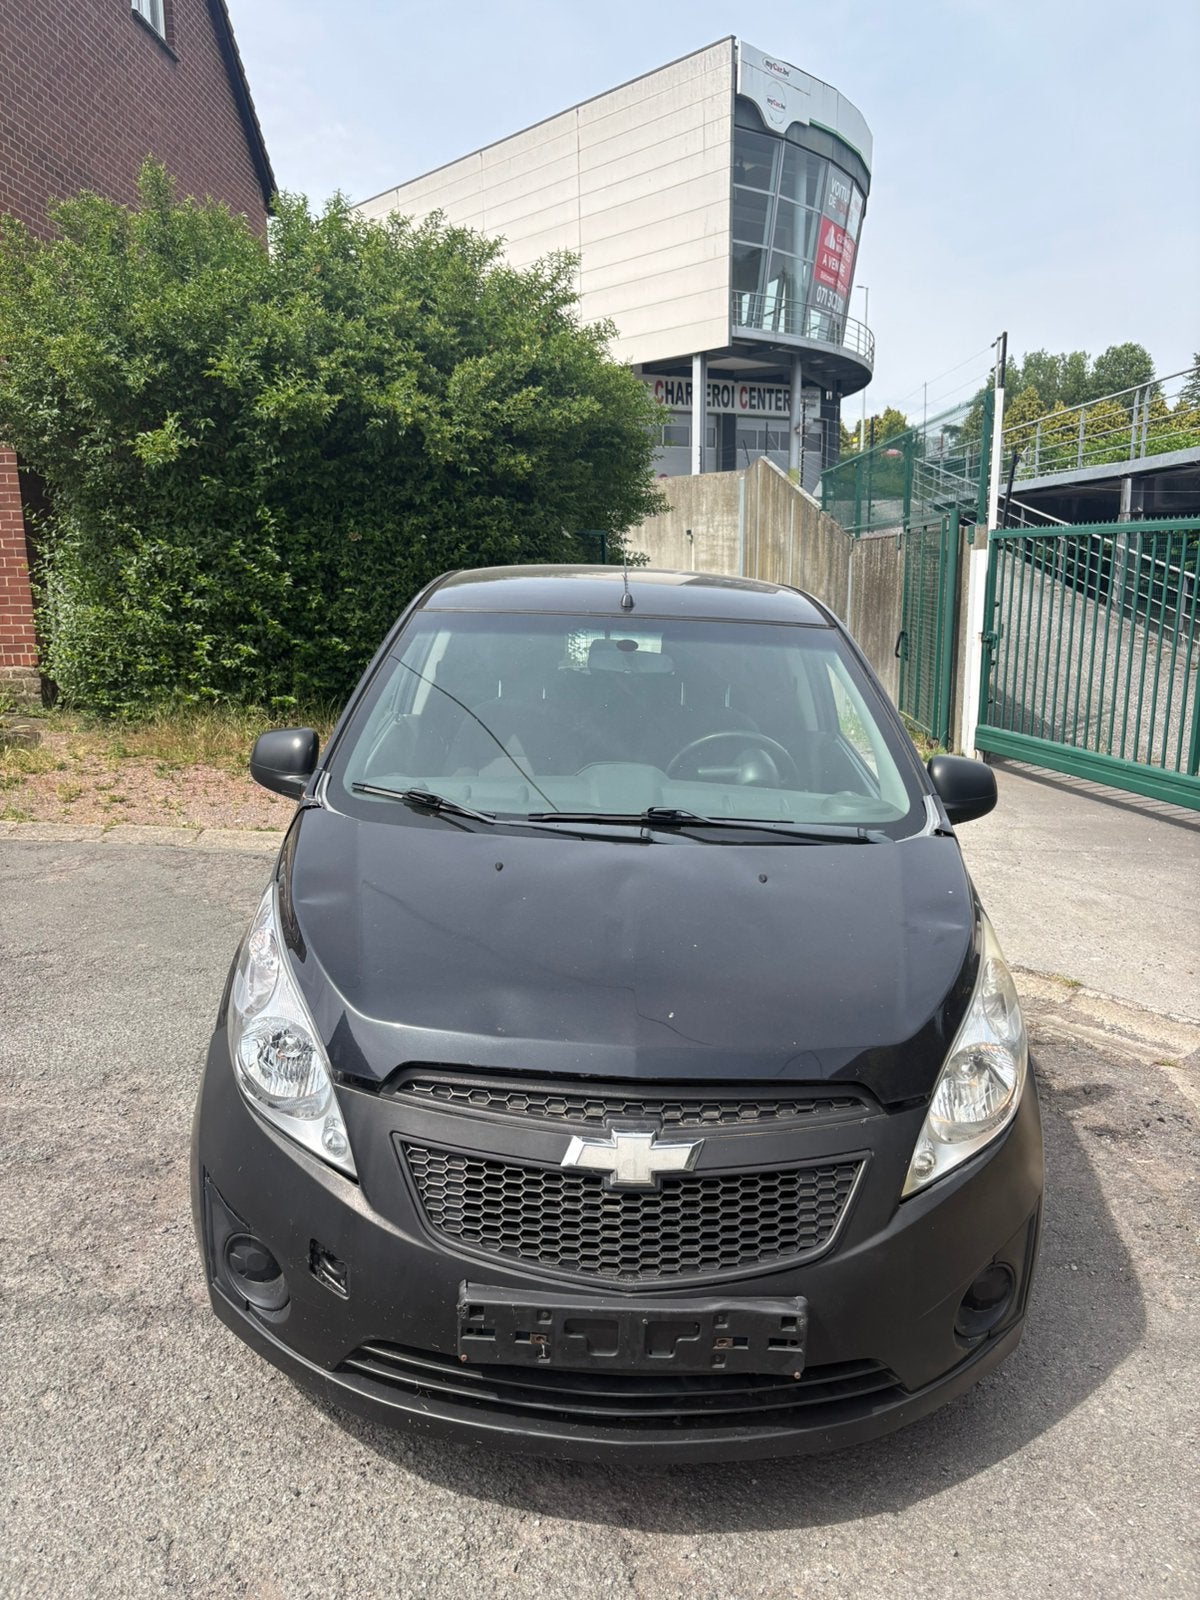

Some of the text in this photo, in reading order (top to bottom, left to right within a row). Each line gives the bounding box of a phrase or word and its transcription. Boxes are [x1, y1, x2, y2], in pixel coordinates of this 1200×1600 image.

[828, 255, 846, 278] VENRE
[655, 379, 735, 408] CHAREROI
[739, 386, 791, 412] CENTER
